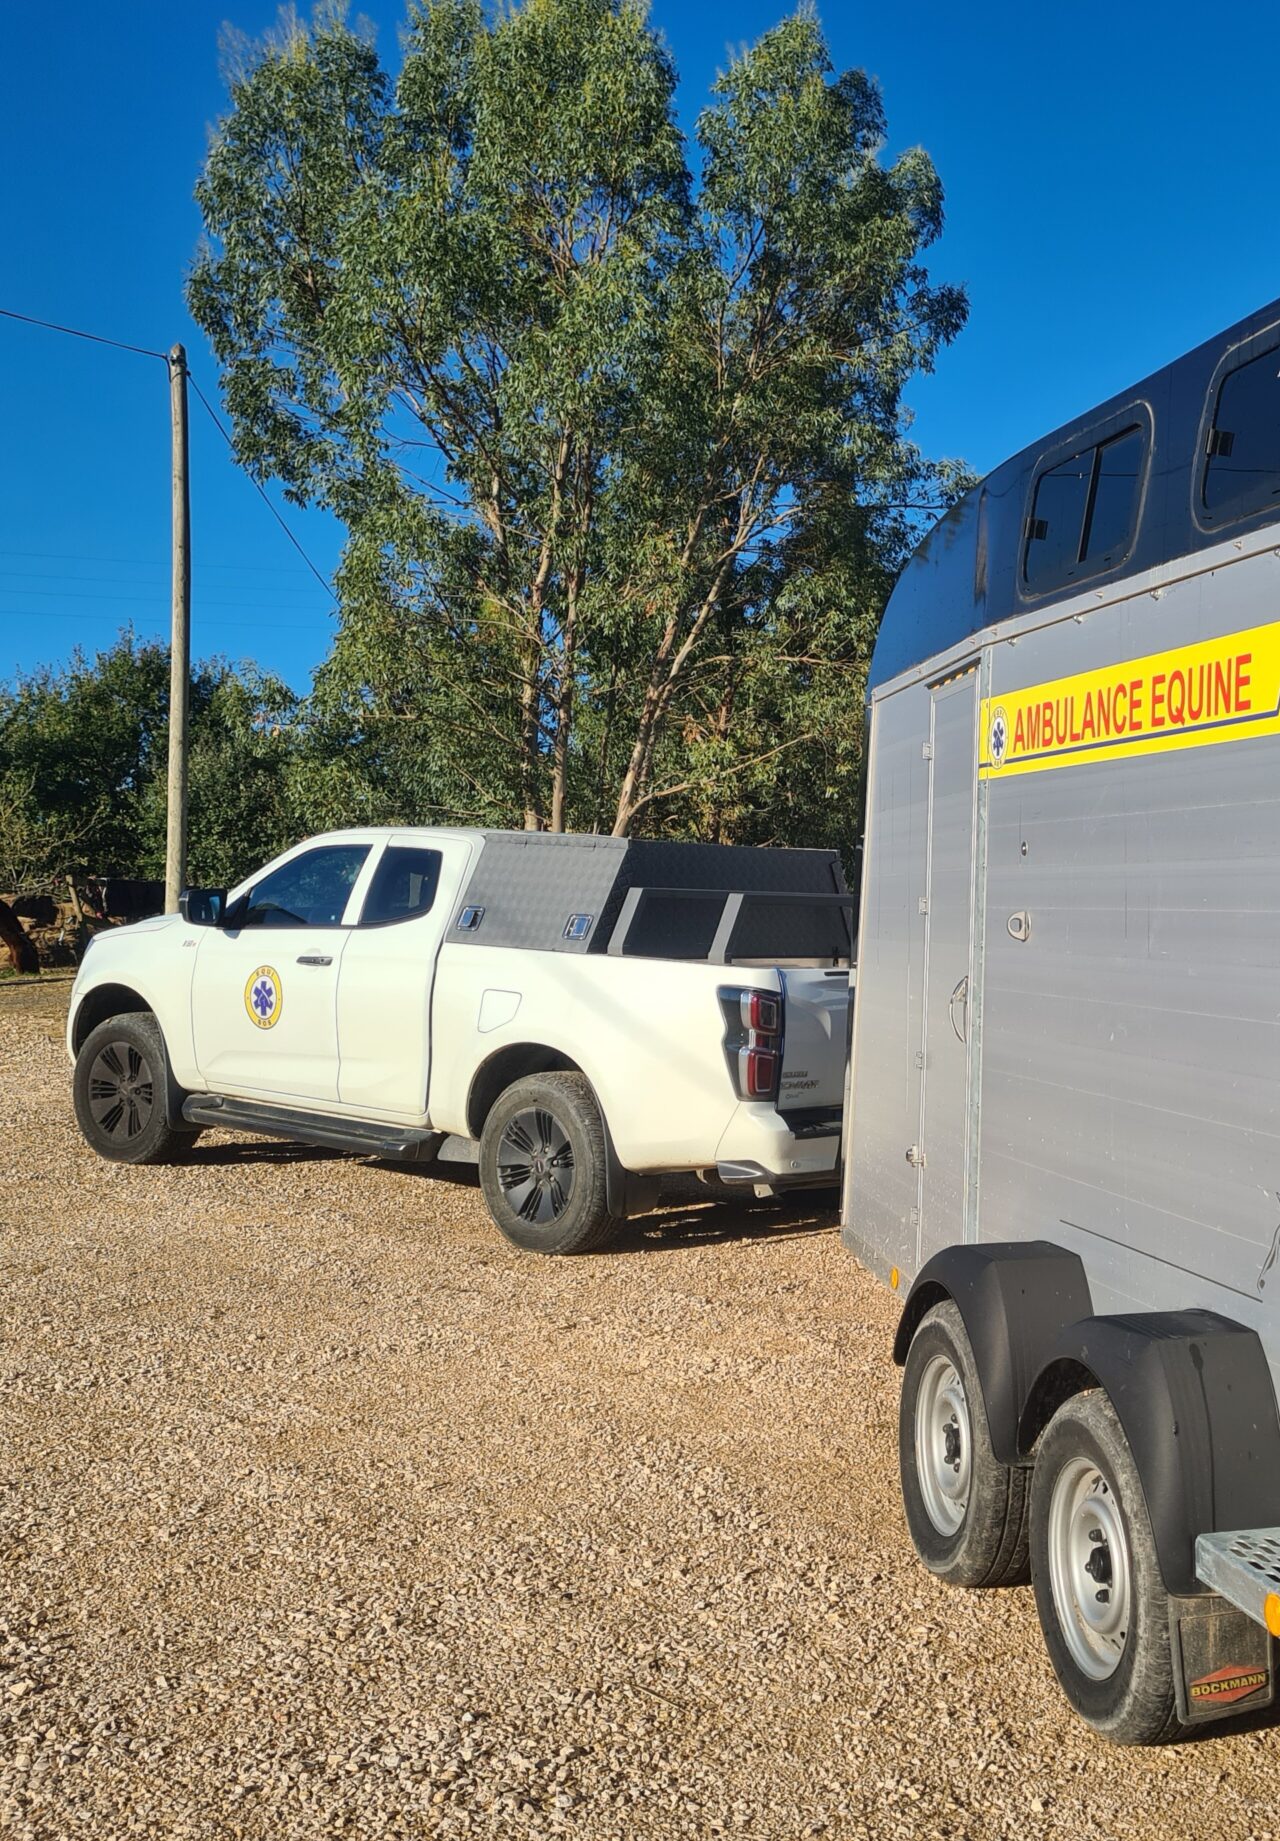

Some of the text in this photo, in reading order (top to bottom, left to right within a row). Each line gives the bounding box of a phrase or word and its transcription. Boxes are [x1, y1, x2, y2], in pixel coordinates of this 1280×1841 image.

[1012, 653, 1253, 753] AMBULANCE EQUINE
[256, 967, 275, 977] EQUI
